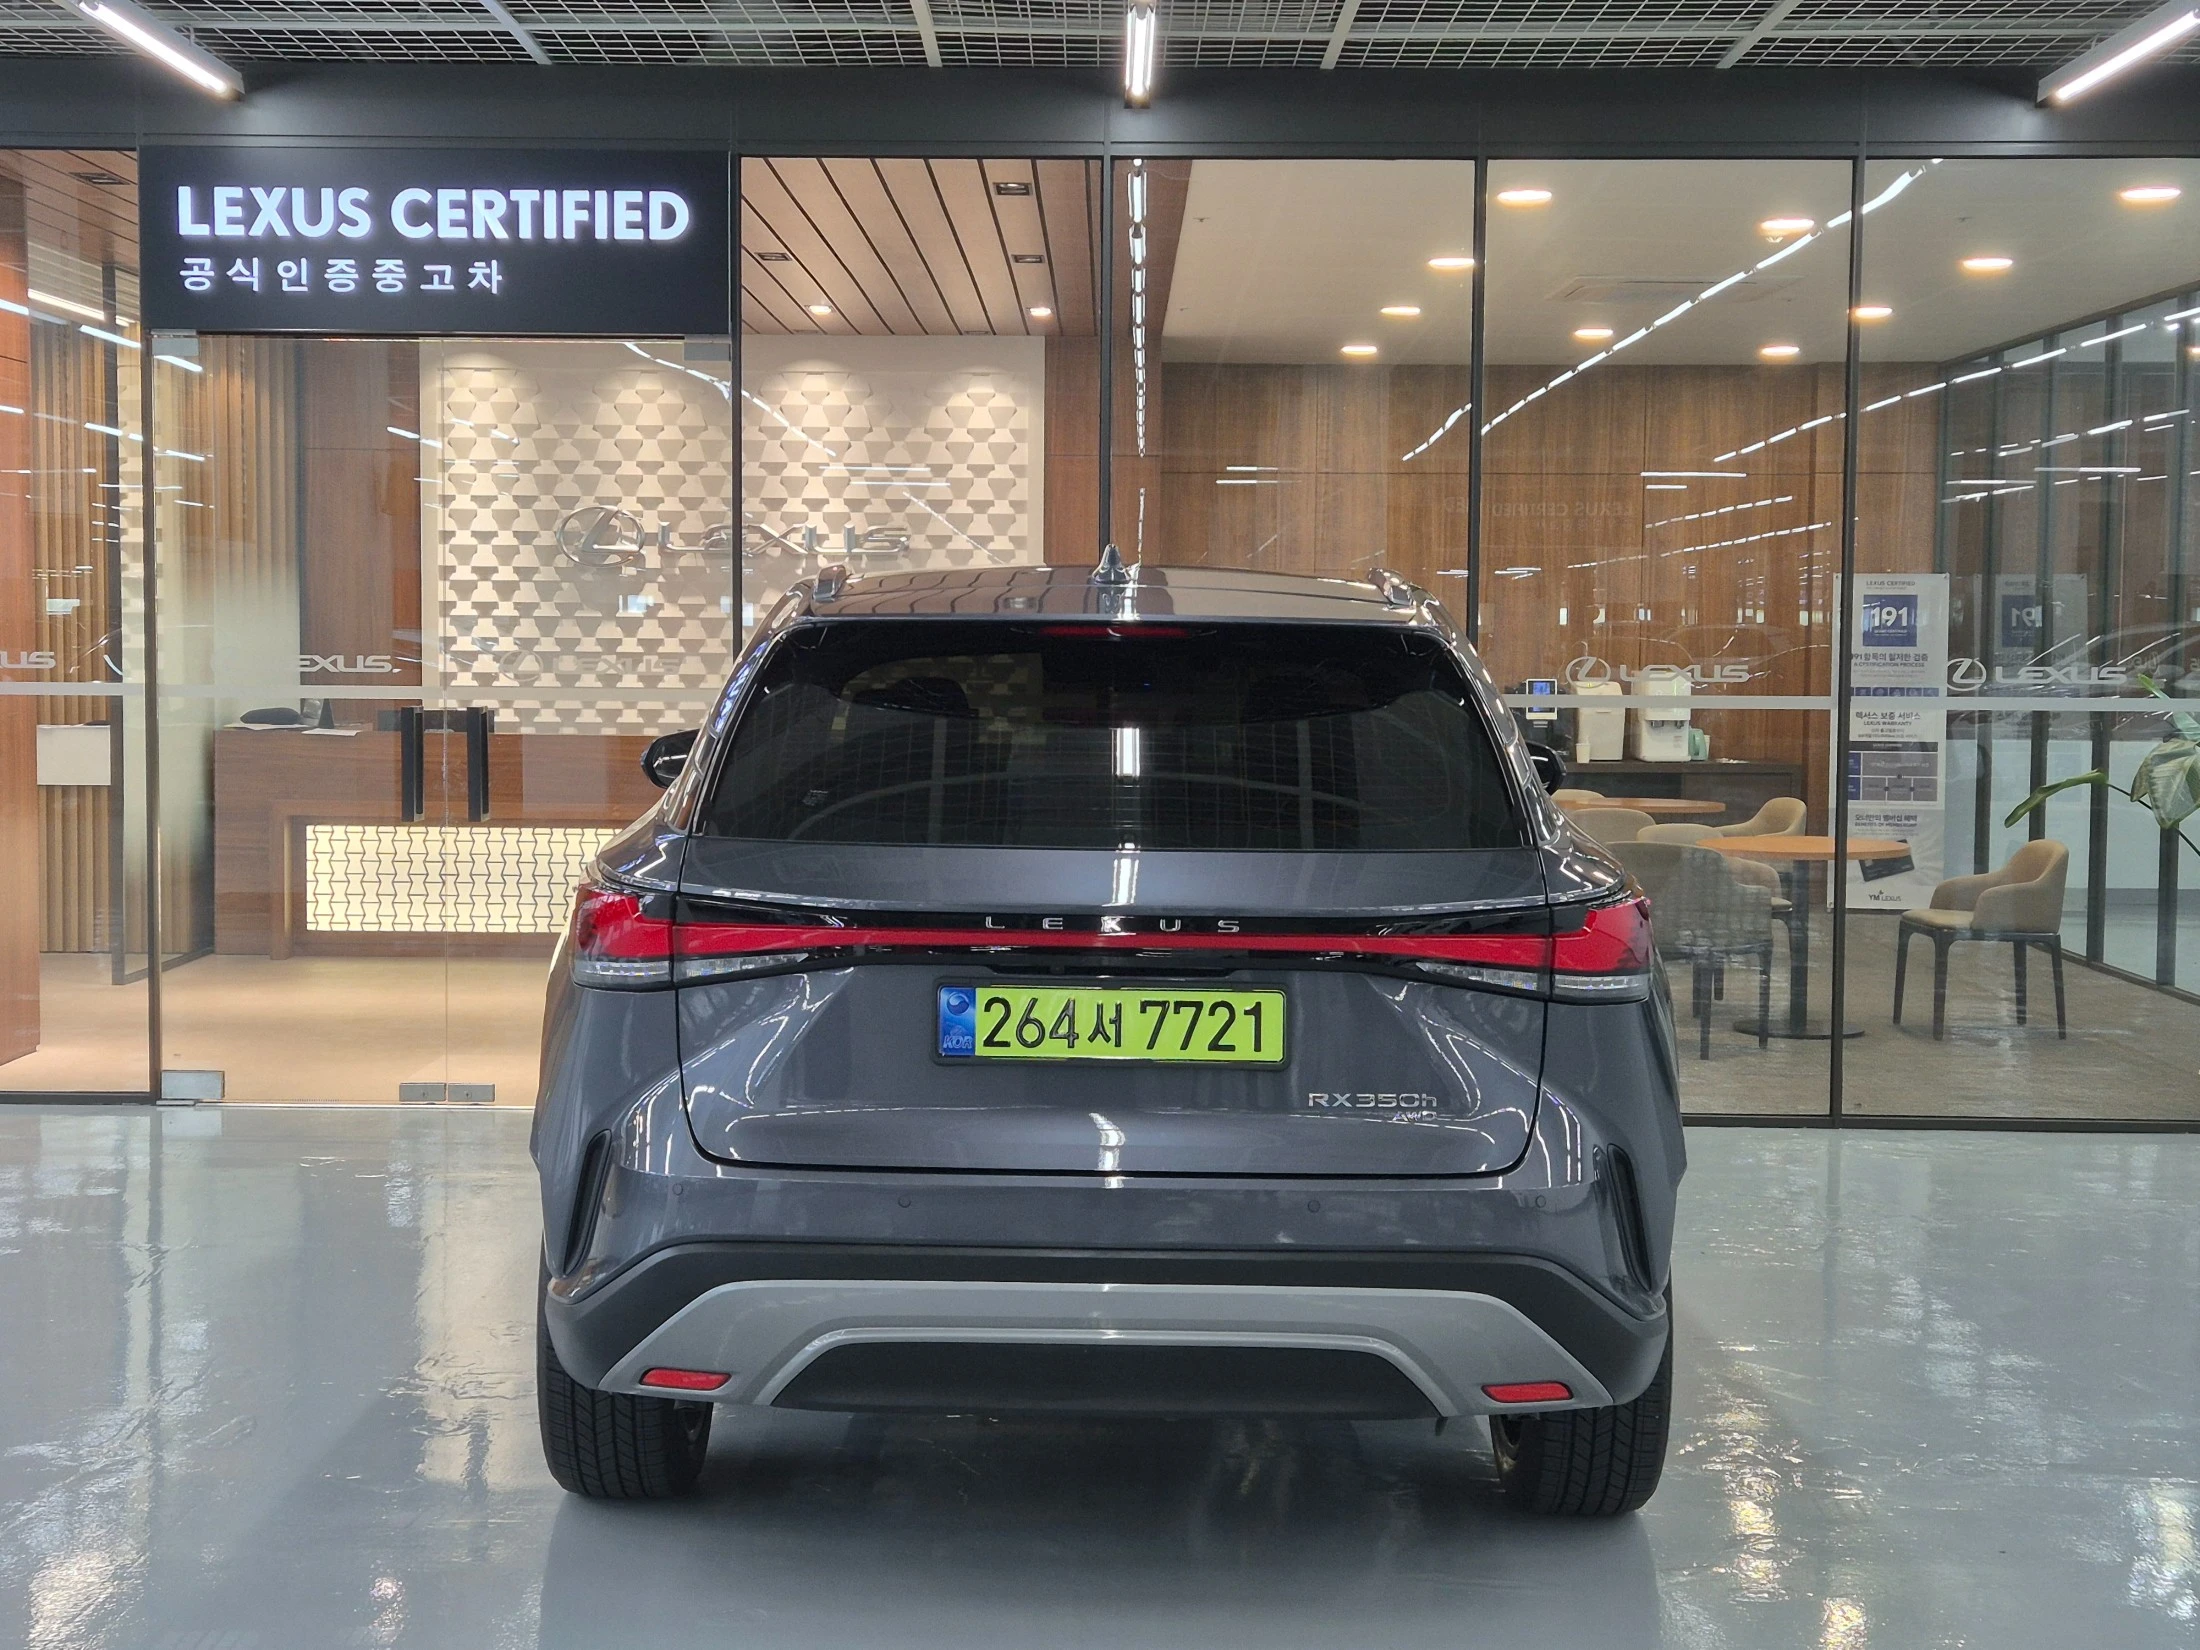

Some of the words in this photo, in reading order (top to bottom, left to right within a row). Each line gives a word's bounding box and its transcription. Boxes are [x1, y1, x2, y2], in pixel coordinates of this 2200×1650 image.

[178, 186, 371, 238] LEXUS
[390, 187, 690, 240] CERTIFIED
[179, 257, 503, 294] 공식인증중고차
[658, 521, 908, 554] LEXUS
[1870, 606, 1908, 627] 191
[553, 656, 682, 675] LEXUS
[1619, 664, 1750, 683] LEXUS
[1995, 666, 2128, 684] LEXUS
[1880, 711, 1895, 720] 보증
[1898, 712, 1921, 720] 서비스
[985, 915, 1241, 934] LEXUS
[982, 996, 1122, 1049] 264서
[1139, 999, 1263, 1053] 7721
[943, 1034, 973, 1049] KOR
[1392, 1110, 1438, 1122] AWD
